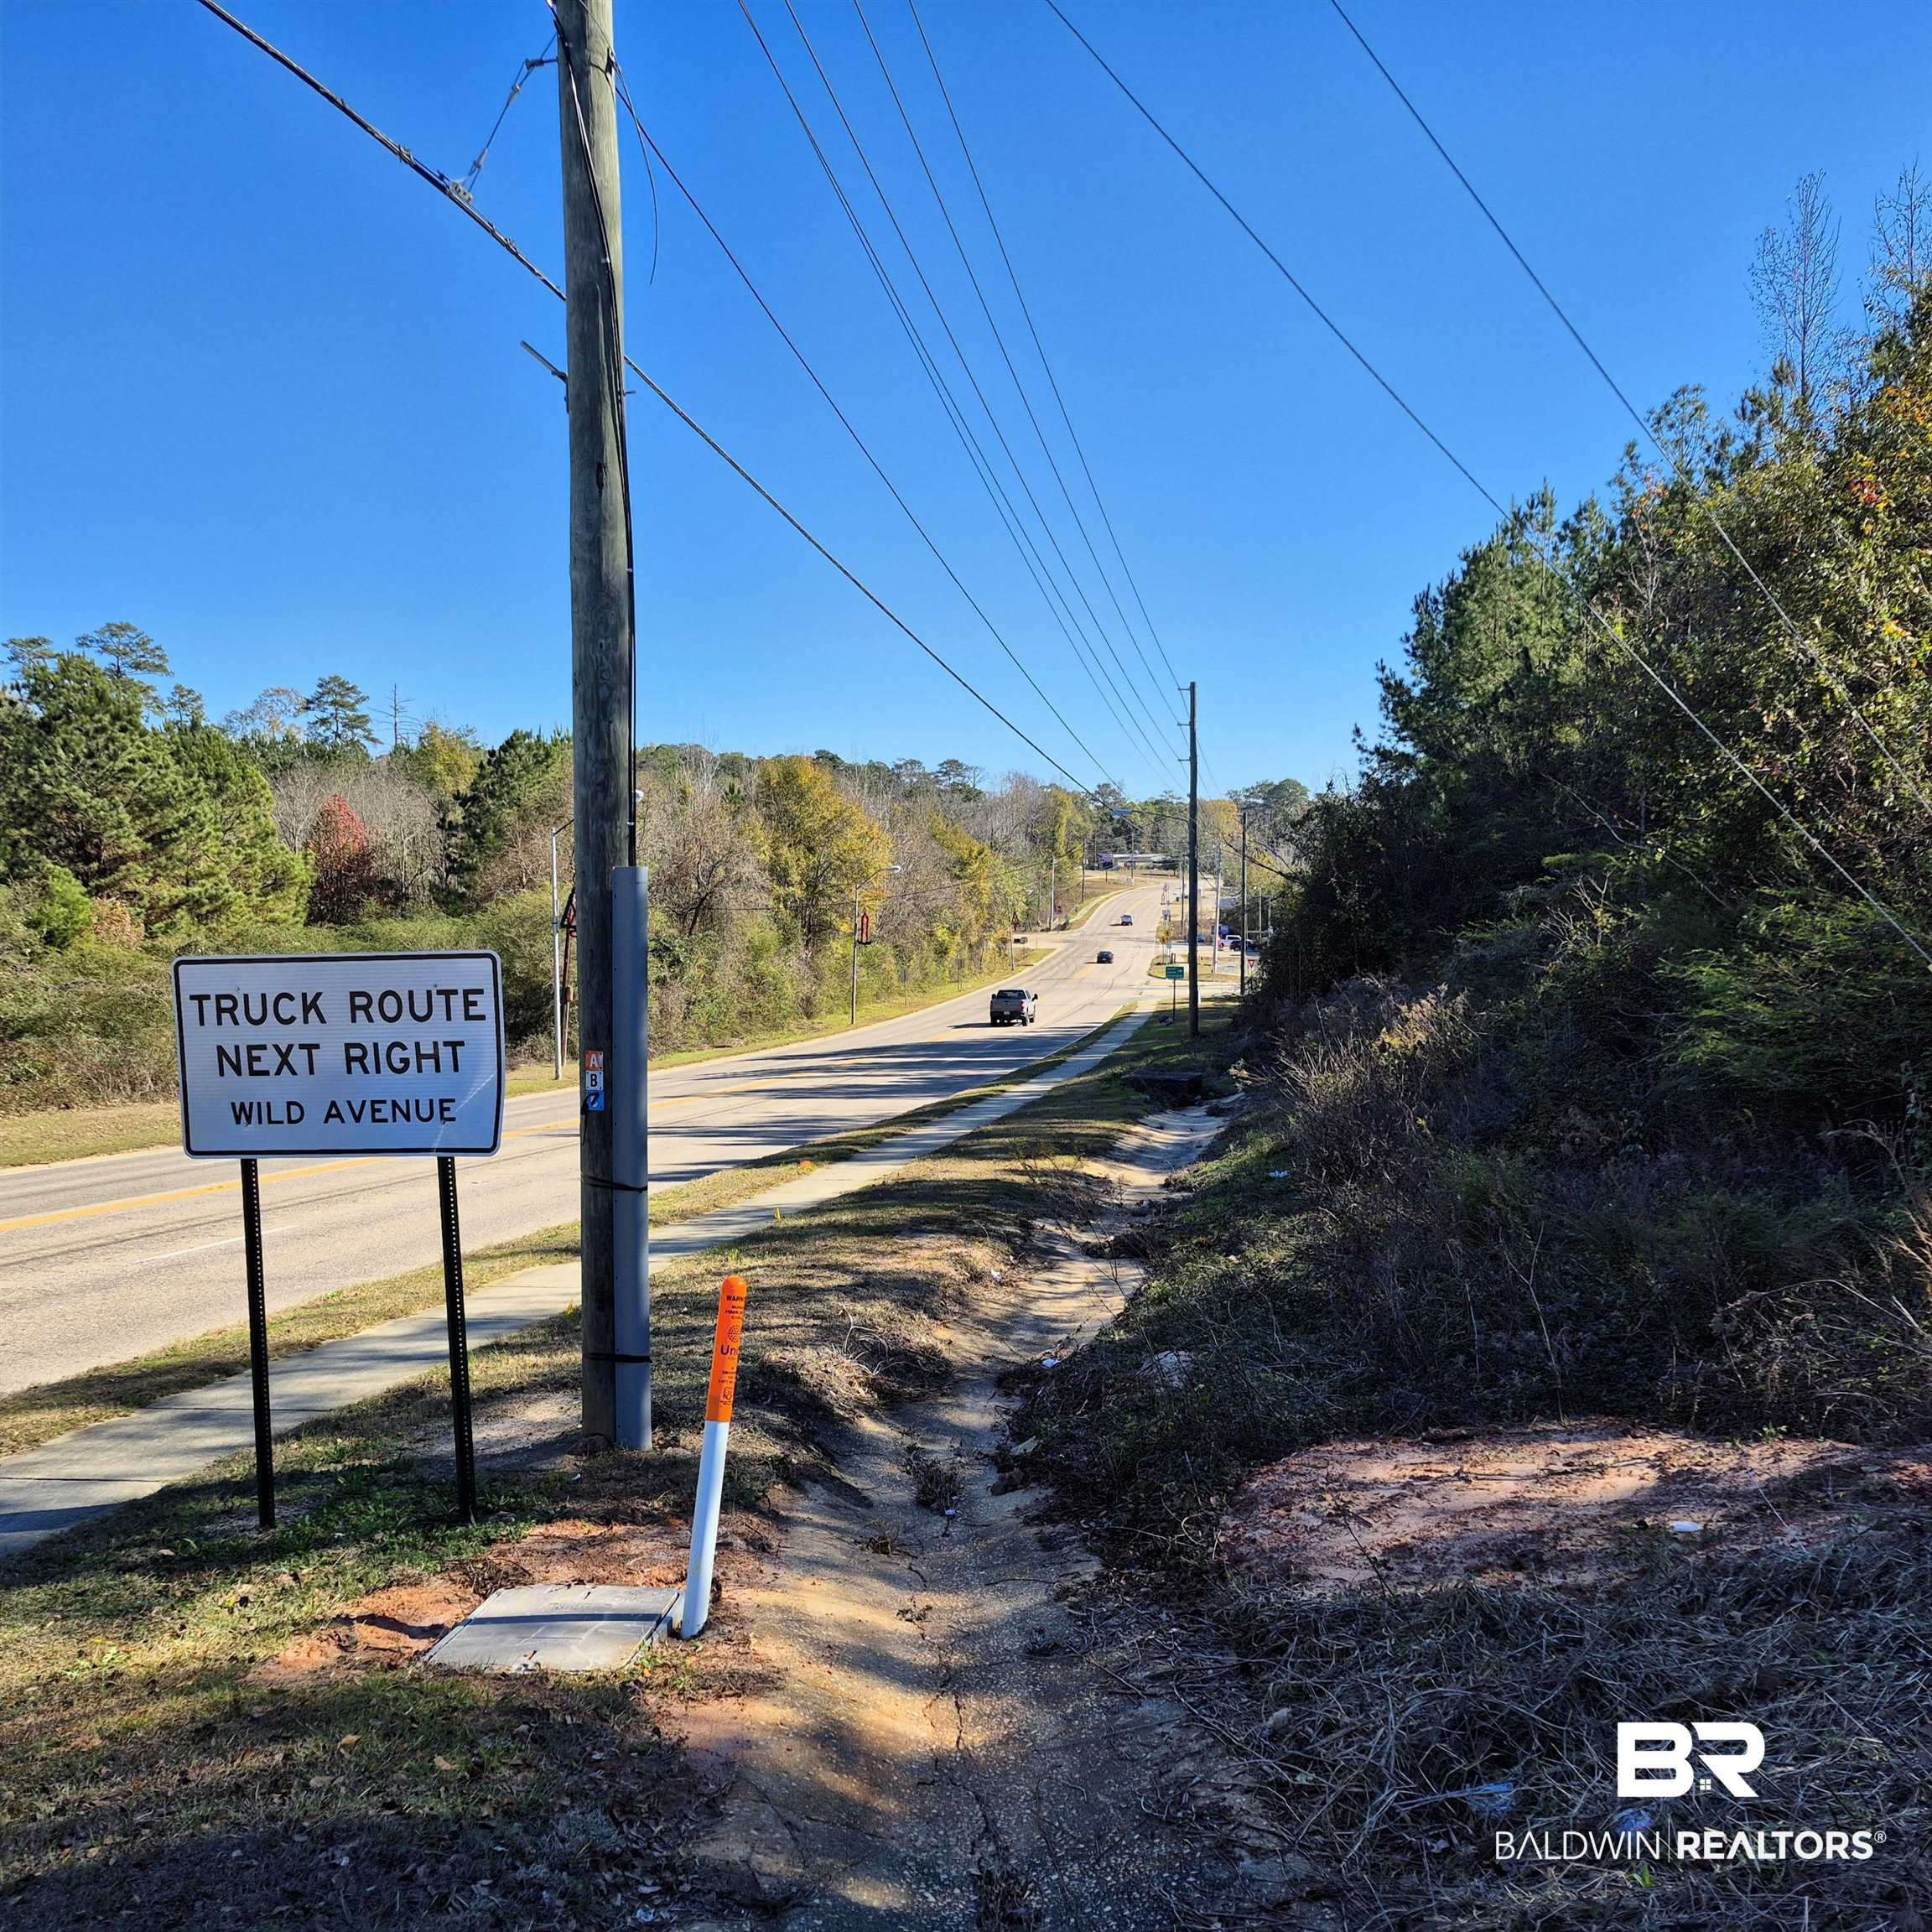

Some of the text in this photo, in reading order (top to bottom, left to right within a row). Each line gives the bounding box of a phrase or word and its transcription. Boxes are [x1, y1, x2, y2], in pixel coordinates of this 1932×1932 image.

[189, 988, 486, 1026] TRUCK ROUTE
[216, 1041, 465, 1077] NEXT RIGHT
[589, 1053, 599, 1067] A
[590, 1073, 598, 1088] B
[231, 1098, 457, 1125] WILD AVENUE
